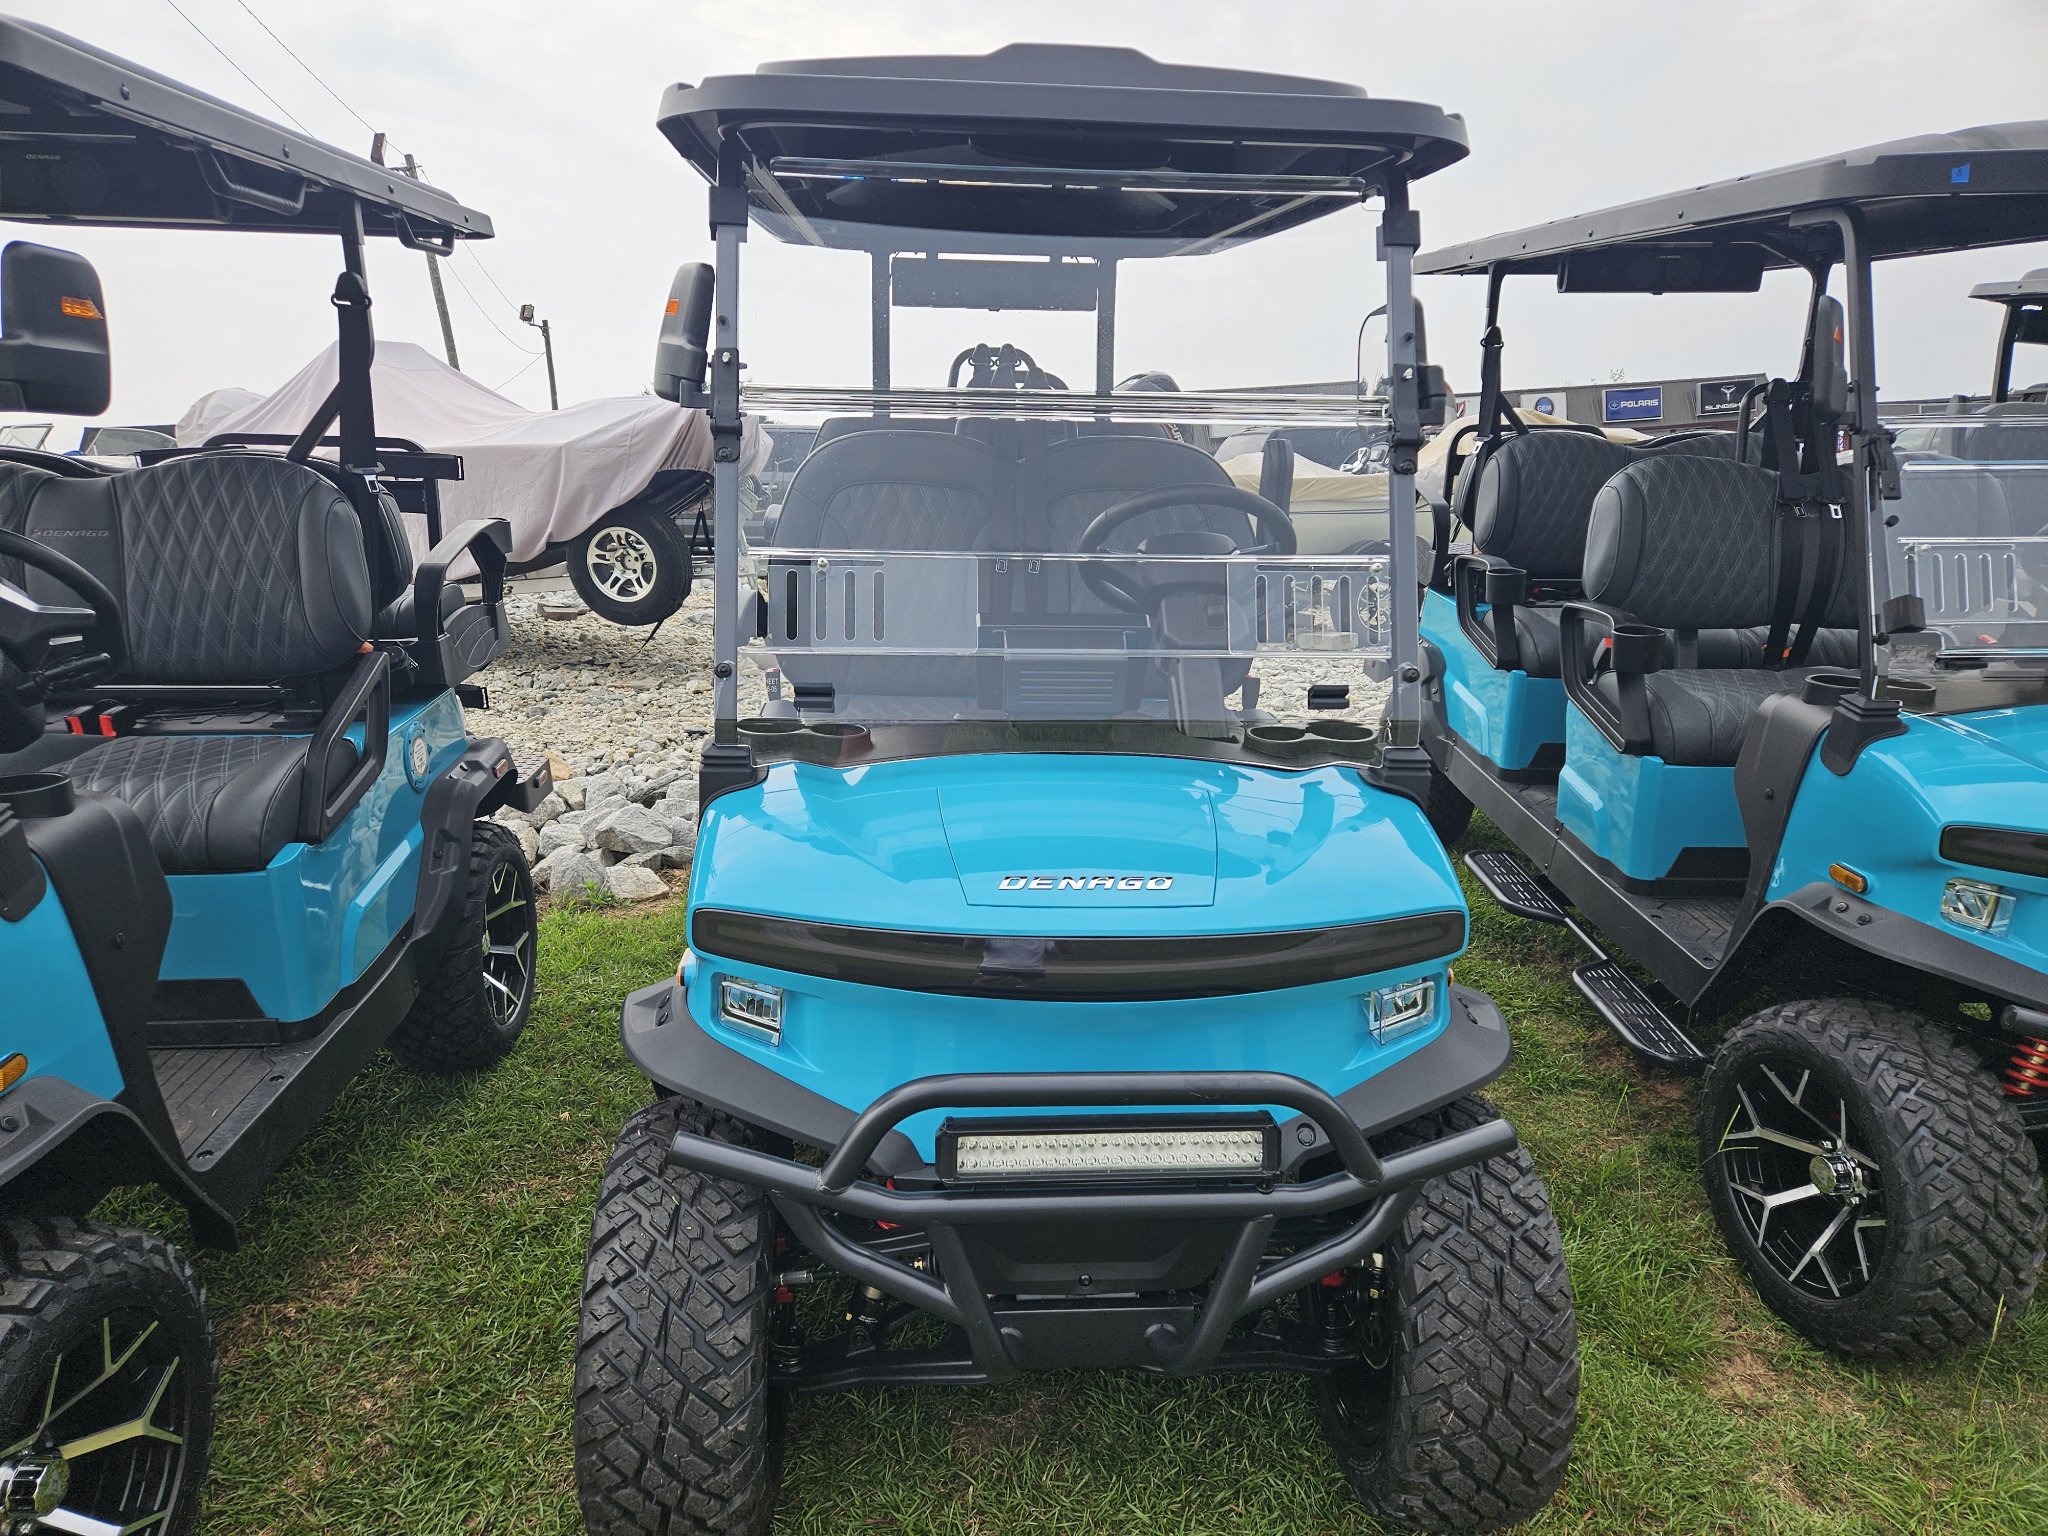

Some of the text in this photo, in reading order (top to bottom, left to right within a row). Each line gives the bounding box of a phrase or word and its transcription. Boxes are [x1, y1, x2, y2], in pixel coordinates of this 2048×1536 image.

[1620, 399, 1659, 408] POLARIS
[1705, 402, 1741, 411] SLINGSH
[41, 529, 109, 537] DENAGO
[998, 876, 1174, 890] DENAGO
